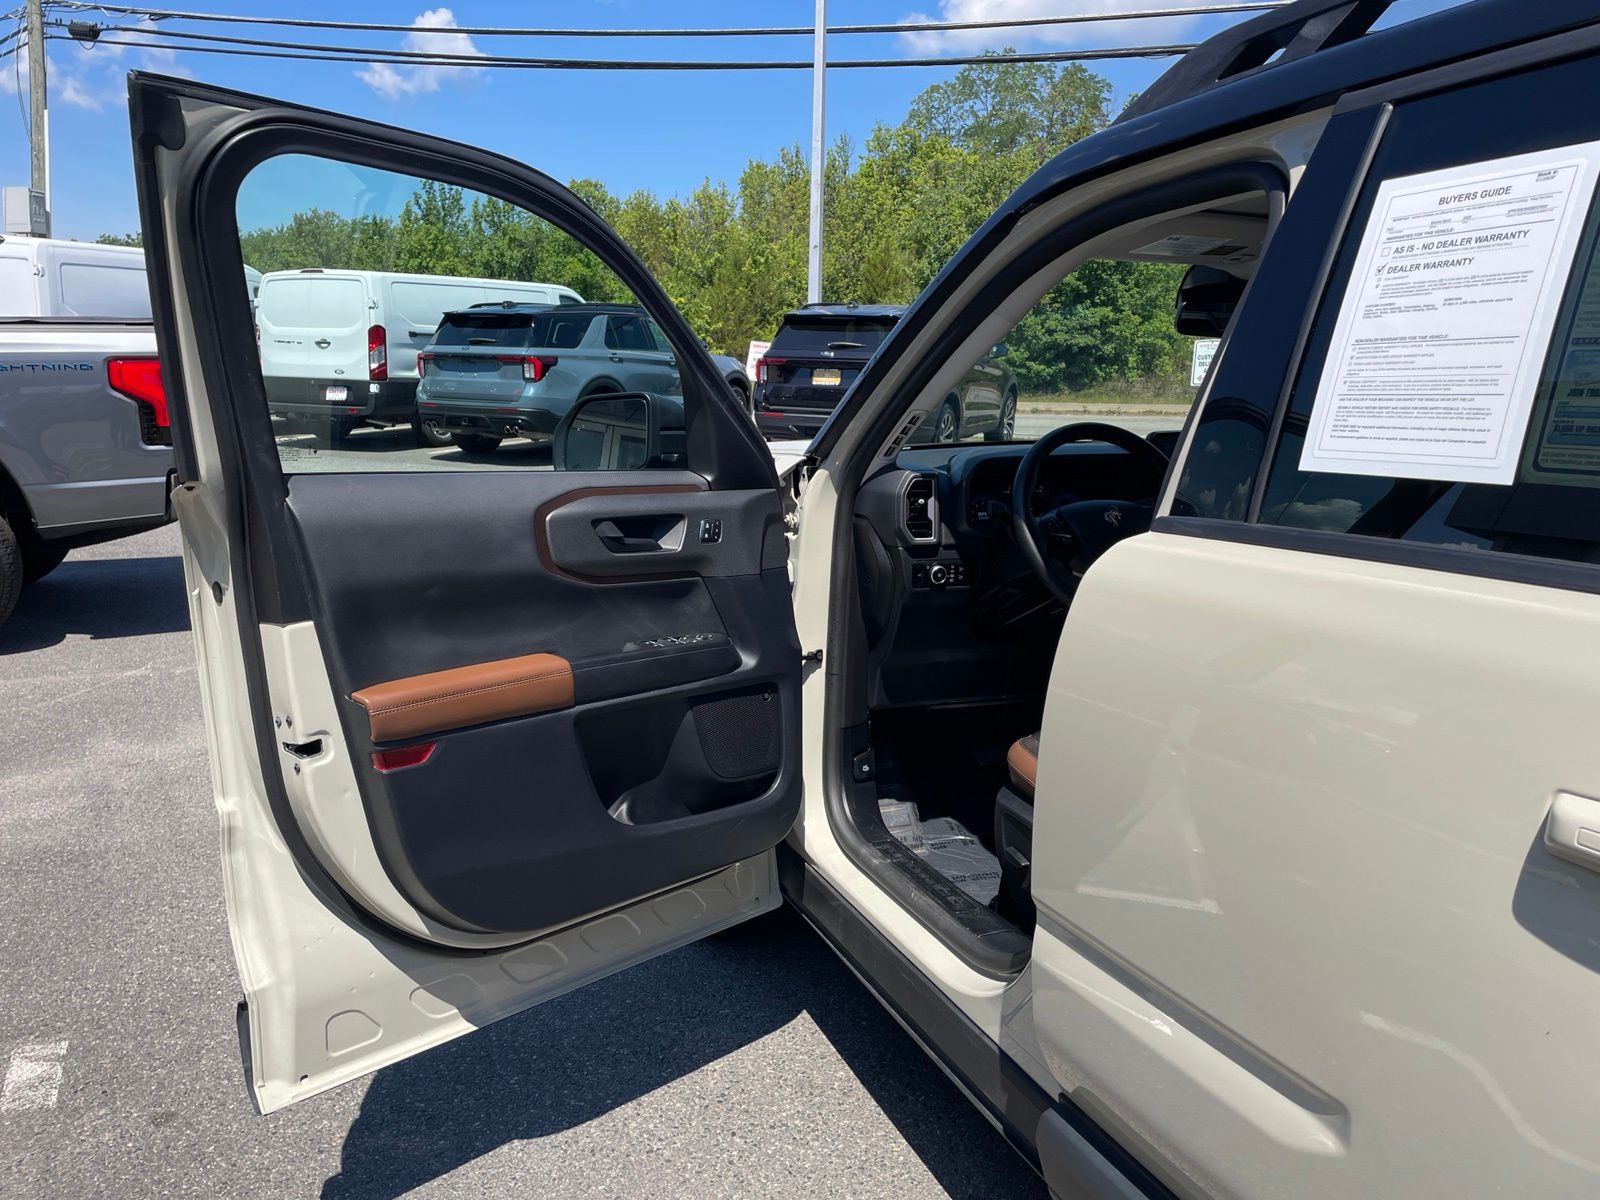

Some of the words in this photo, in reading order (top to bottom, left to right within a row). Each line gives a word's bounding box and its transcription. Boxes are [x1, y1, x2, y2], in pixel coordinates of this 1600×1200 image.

[1438, 190, 1478, 206] BUYERS
[1480, 185, 1513, 199] GUIDE
[1393, 246, 1405, 255] AS
[1406, 245, 1415, 253] IS
[1421, 242, 1435, 251] NO
[1435, 237, 1473, 249] DEALER
[1474, 229, 1530, 244] WARRANTY
[1386, 262, 1421, 275] DEALER
[1422, 257, 1475, 271] WARRANTY
